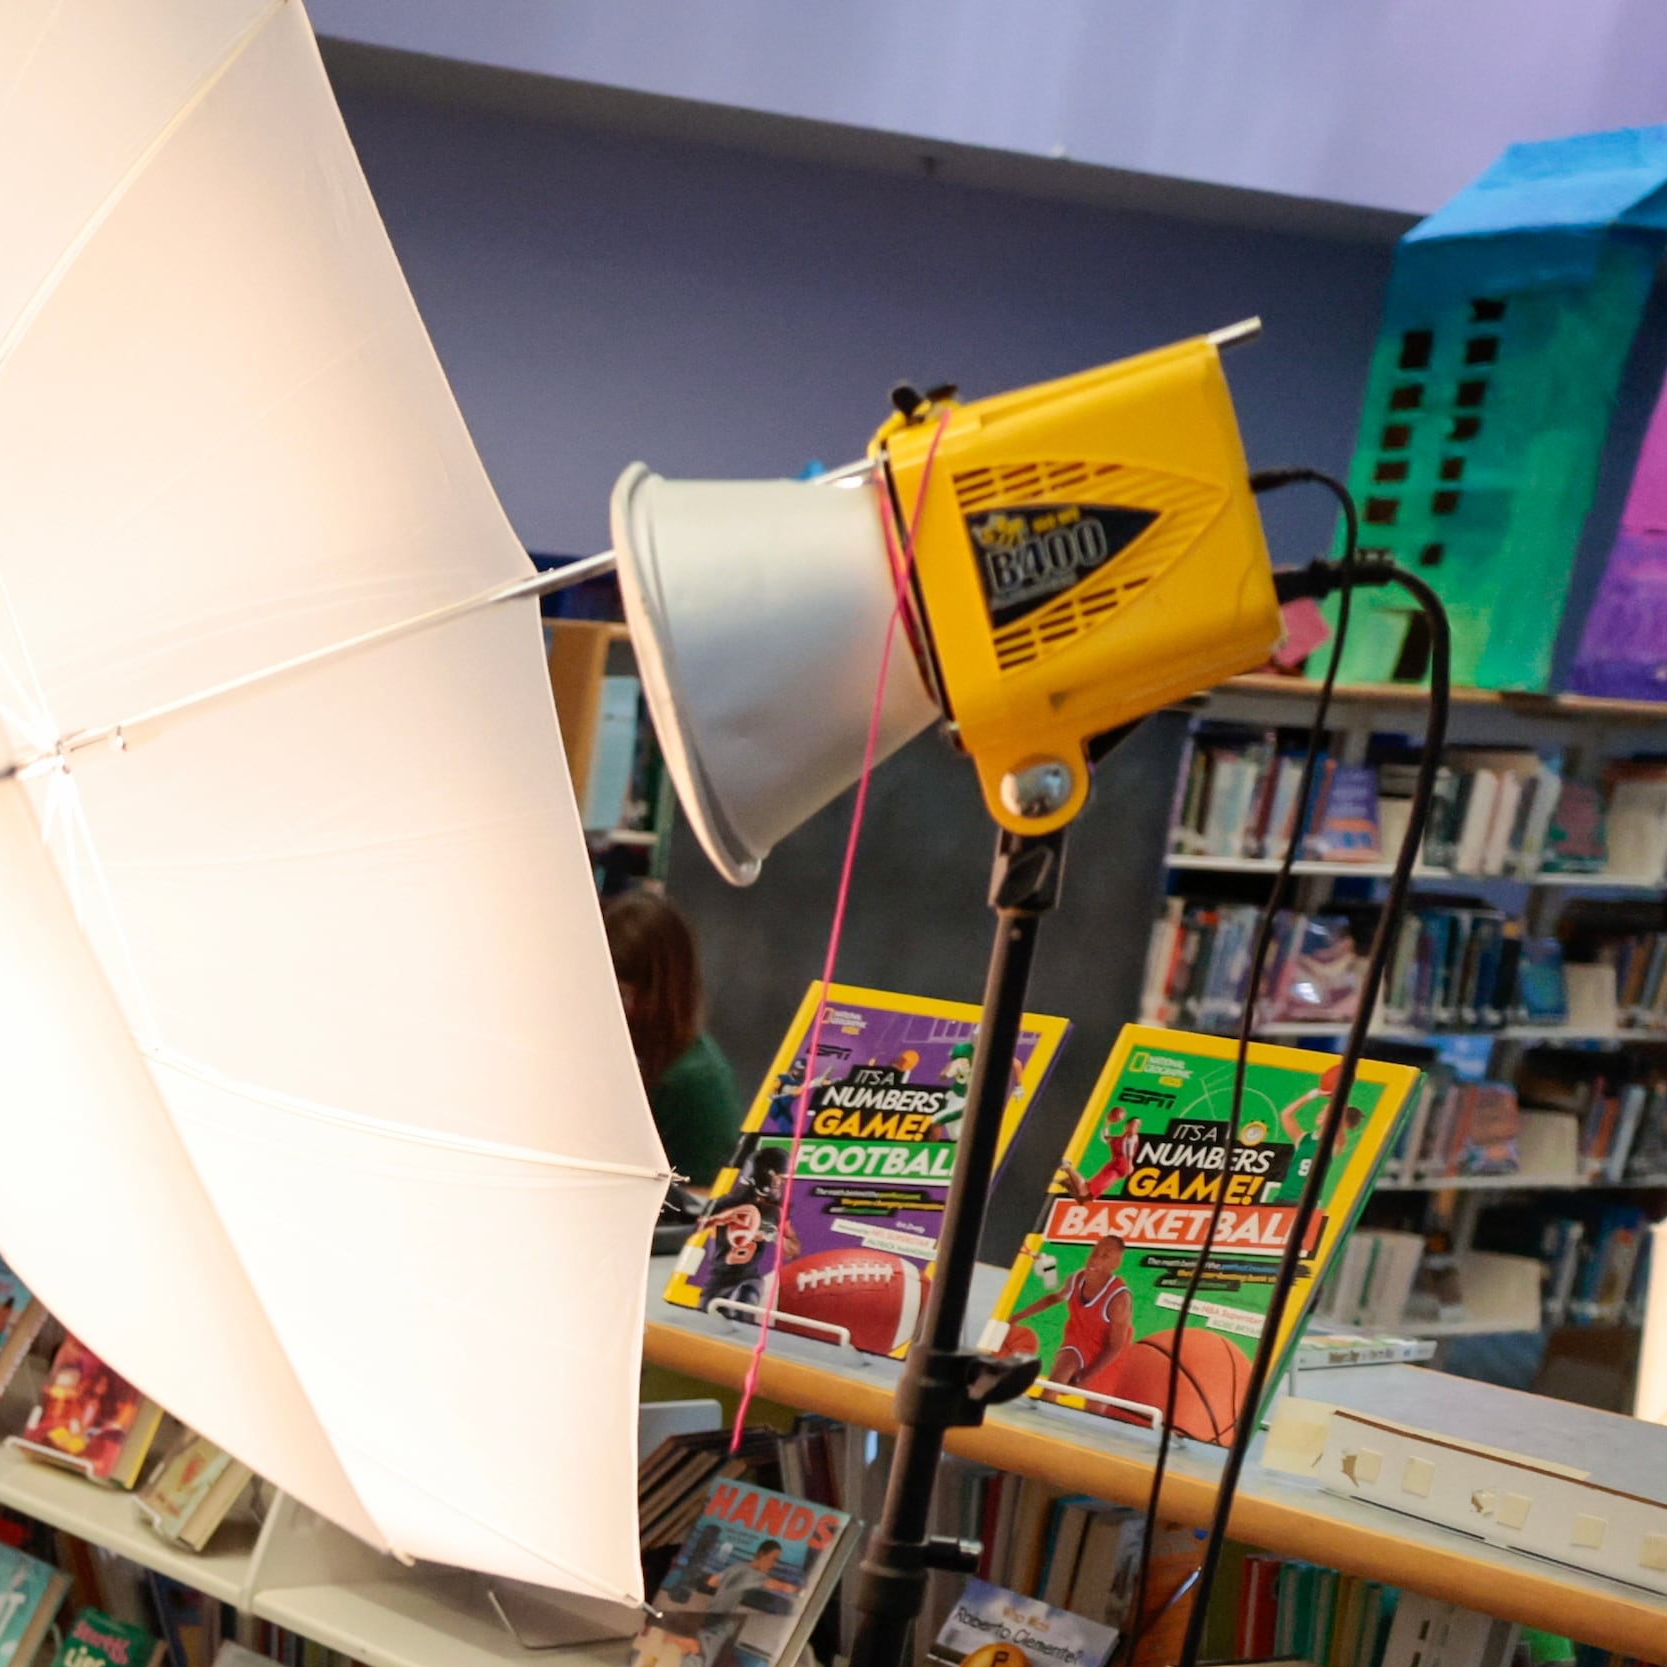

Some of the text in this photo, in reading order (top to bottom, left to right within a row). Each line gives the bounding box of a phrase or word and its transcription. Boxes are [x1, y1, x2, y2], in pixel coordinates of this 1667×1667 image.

[986, 518, 1108, 596] B400
[881, 1071, 896, 1086] A
[822, 1085, 945, 1114] NUMBERS
[1117, 1087, 1177, 1110] ESPN
[813, 1107, 934, 1141] GAME!
[1202, 1126, 1218, 1142] A
[793, 1144, 957, 1177] FOOTBAL
[1136, 1141, 1275, 1174] NUMBERS
[1127, 1167, 1265, 1206] GAME!
[1056, 1205, 1297, 1246] BASKETBAL
[703, 1484, 841, 1551] HANDS
[954, 1605, 1085, 1666] Roberto Clemente?
